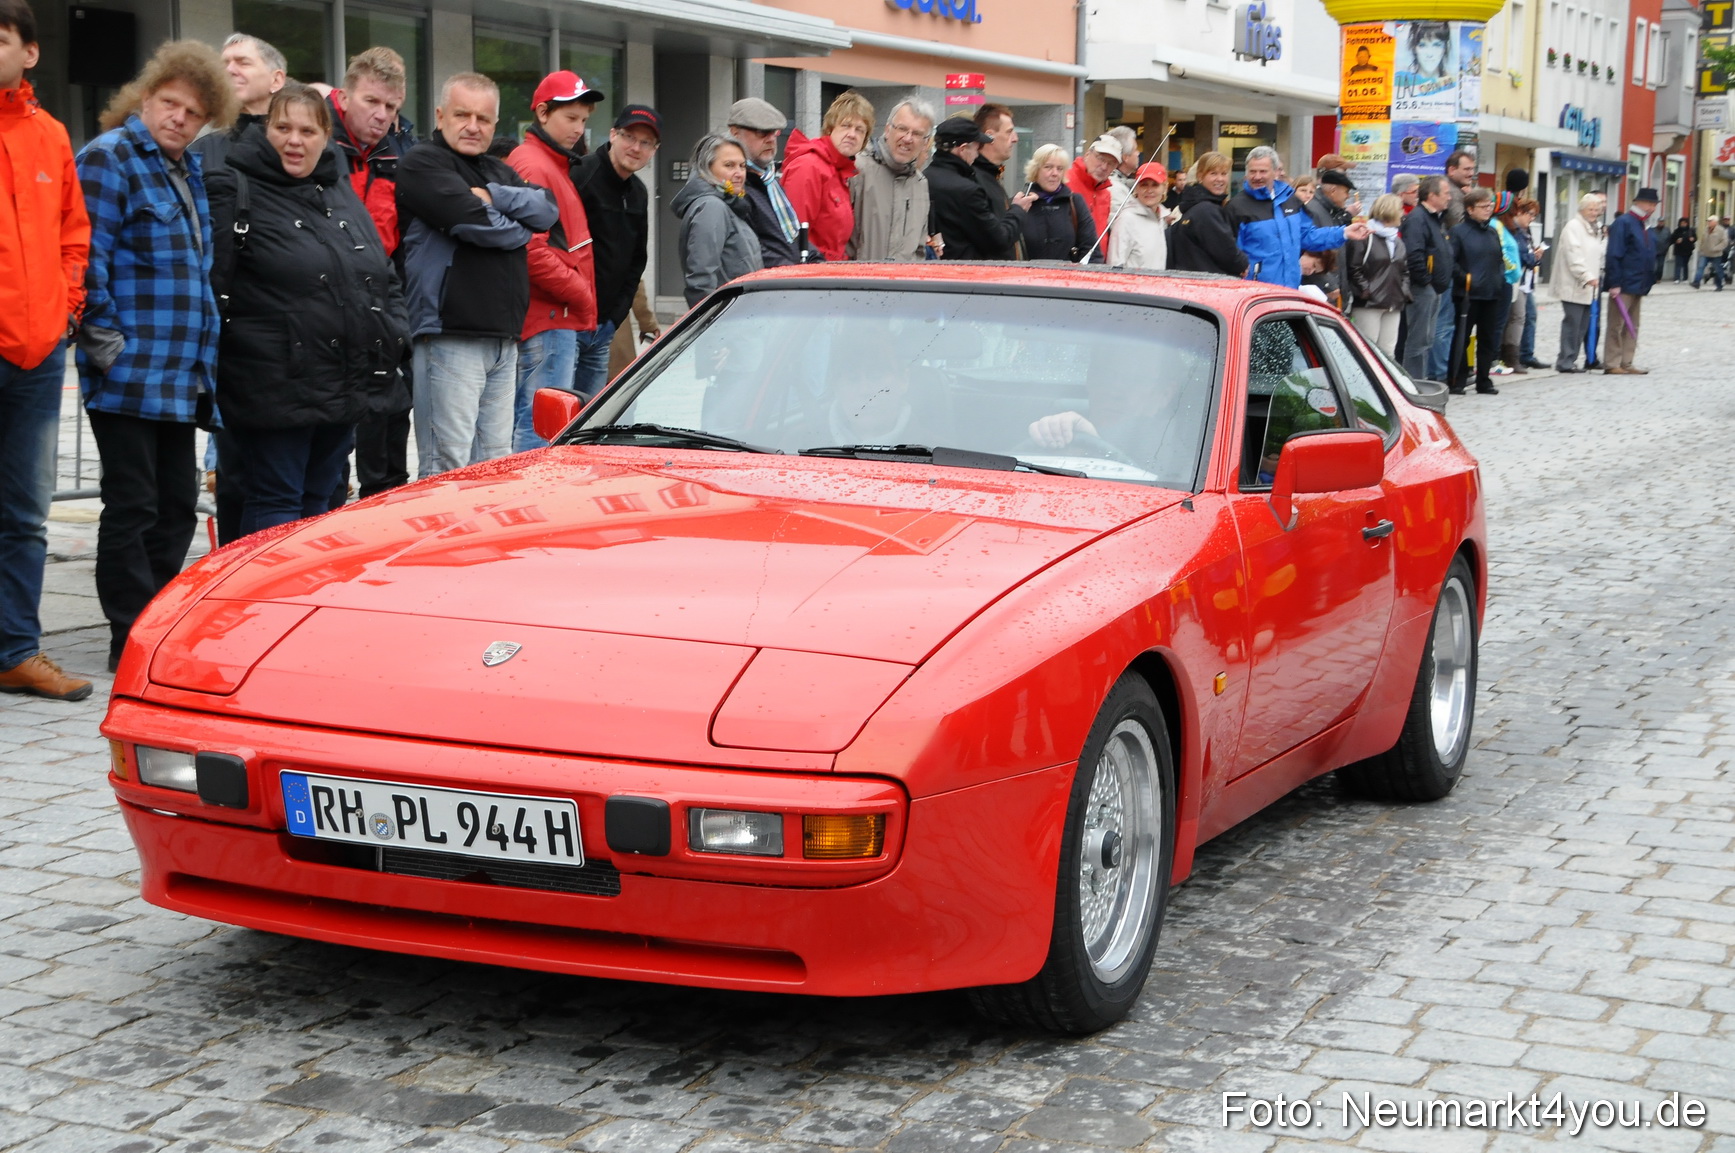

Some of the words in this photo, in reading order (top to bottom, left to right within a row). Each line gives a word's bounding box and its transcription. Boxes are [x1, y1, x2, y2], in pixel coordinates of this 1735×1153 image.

[1245, 1, 1282, 60] fries
[1347, 76, 1384, 87] Samstag
[1347, 87, 1381, 98] 01.06.
[1220, 124, 1257, 135] FRIES
[296, 810, 306, 824] D
[311, 785, 366, 835] RH
[392, 794, 447, 844] PL
